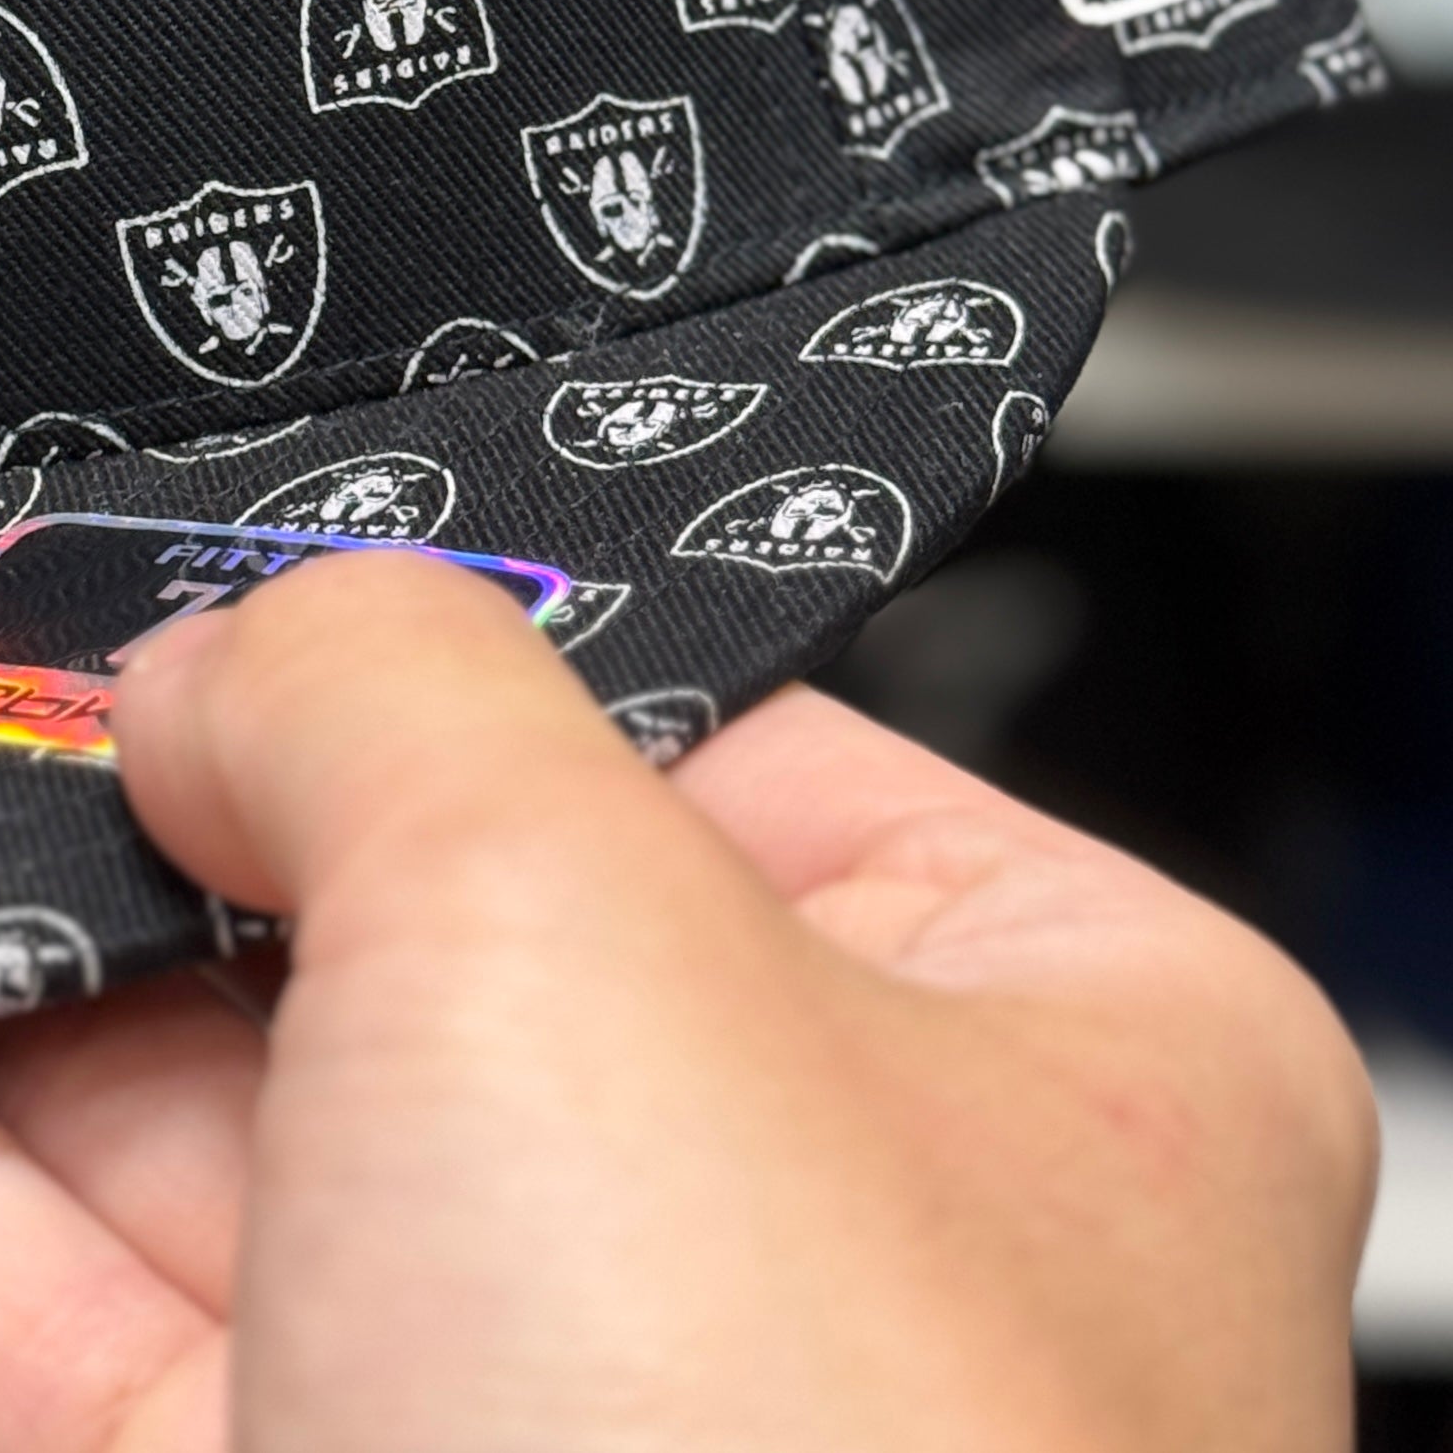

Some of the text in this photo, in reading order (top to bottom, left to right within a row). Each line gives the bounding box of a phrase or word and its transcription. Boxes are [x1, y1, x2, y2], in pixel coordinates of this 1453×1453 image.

[334, 46, 471, 92] RAIDERS
[547, 113, 674, 154] RAIDERS
[145, 200, 295, 247] RAIDERS
[154, 544, 300, 575] FITT
[707, 537, 872, 559] RAIDERS
